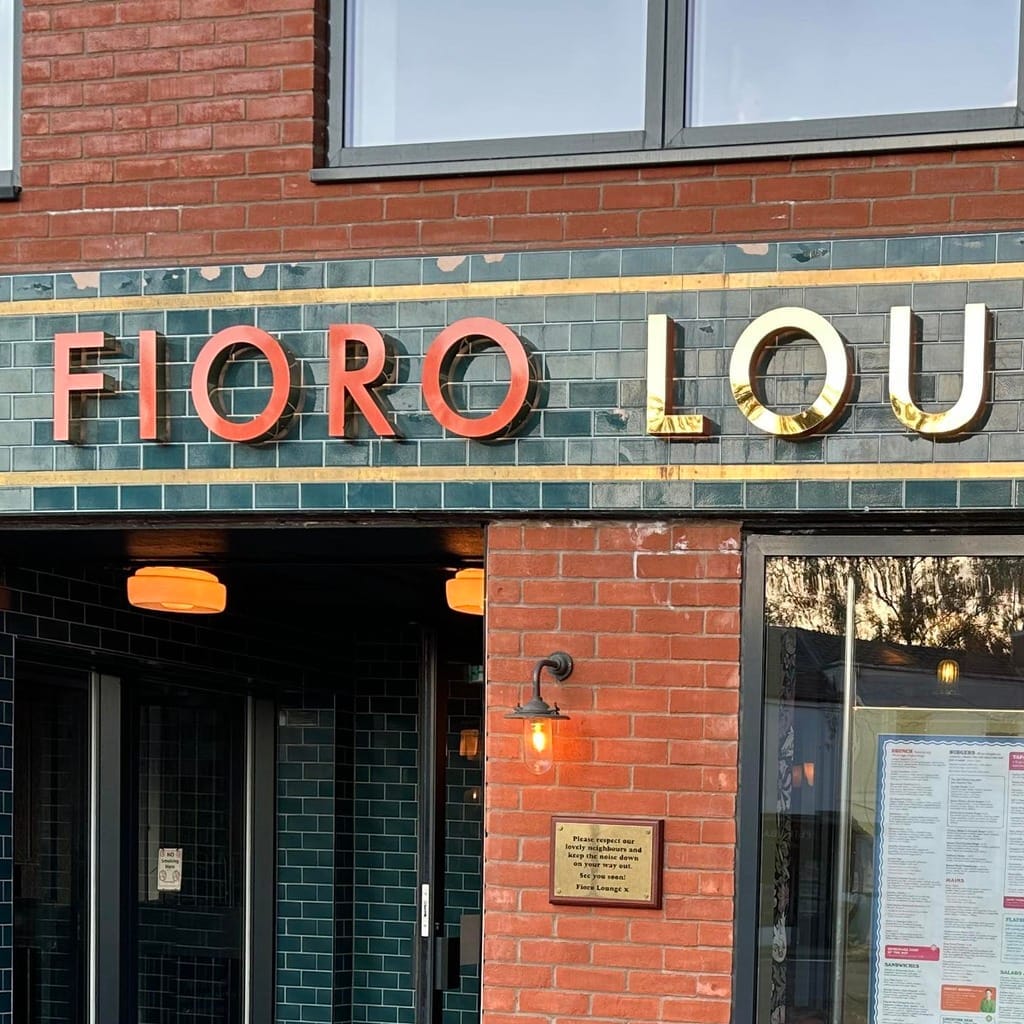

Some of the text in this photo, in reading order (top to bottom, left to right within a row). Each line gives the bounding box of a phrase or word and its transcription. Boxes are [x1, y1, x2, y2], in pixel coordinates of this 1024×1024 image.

[53, 316, 535, 444] FIORO
[572, 835, 594, 843] Please
[596, 837, 621, 845] respect
[565, 843, 586, 851] lovely
[587, 845, 627, 853] neighbours
[567, 852, 585, 860] keep
[596, 885, 622, 893] Lounge
